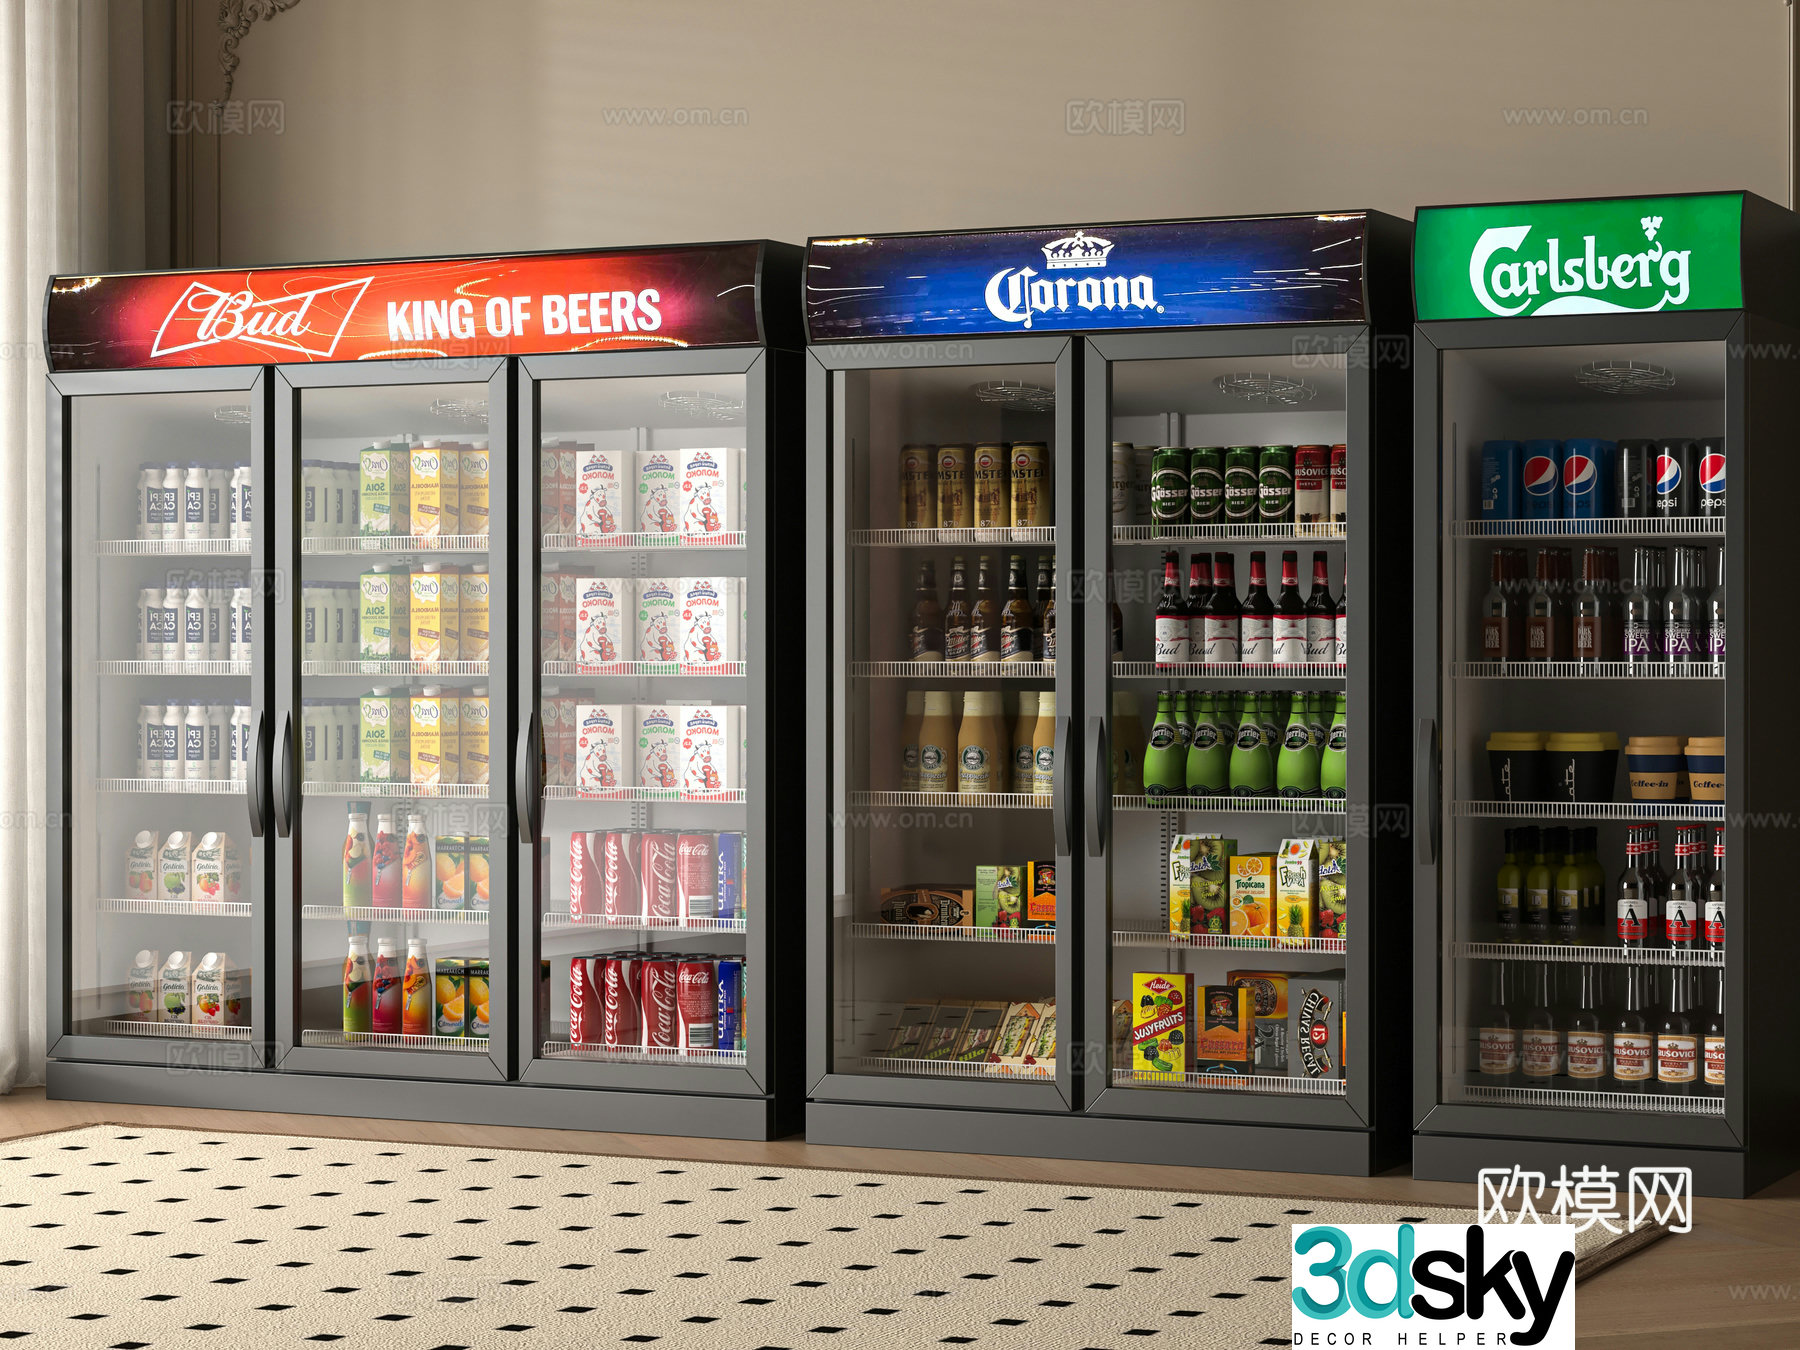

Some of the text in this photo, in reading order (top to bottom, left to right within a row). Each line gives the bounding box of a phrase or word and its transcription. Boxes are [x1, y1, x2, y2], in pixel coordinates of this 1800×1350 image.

[1469, 224, 1692, 317] Carlsberg
[984, 265, 1158, 329] Corona
[187, 291, 312, 341] Bud
[387, 288, 663, 341] KING OF BEERS
[904, 470, 928, 480] MSTE
[938, 470, 965, 480] MSTE
[975, 470, 1002, 479] MSTE
[1011, 469, 1043, 478] MSTE
[1295, 467, 1328, 476] RUŠOVICE
[1155, 485, 1188, 499] Gösser
[1190, 484, 1222, 499] Gösser
[1225, 484, 1257, 499] Gösser
[1259, 483, 1292, 499] Gösser
[1657, 497, 1677, 509] epsi
[1701, 497, 1725, 510] peps
[1156, 642, 1180, 655] Bud
[1307, 642, 1329, 655] Bud
[1625, 638, 1650, 652] IPA
[1665, 638, 1691, 652] IPA
[1235, 877, 1265, 889] Tropicana
[1621, 908, 1641, 926] A
[1669, 910, 1691, 928] A
[1150, 980, 1170, 990] Heide
[1134, 1012, 1183, 1040] JUJYFRUITS
[1614, 1045, 1650, 1056] RUŠOVICE
[1658, 1048, 1695, 1058] RUŠOVICE
